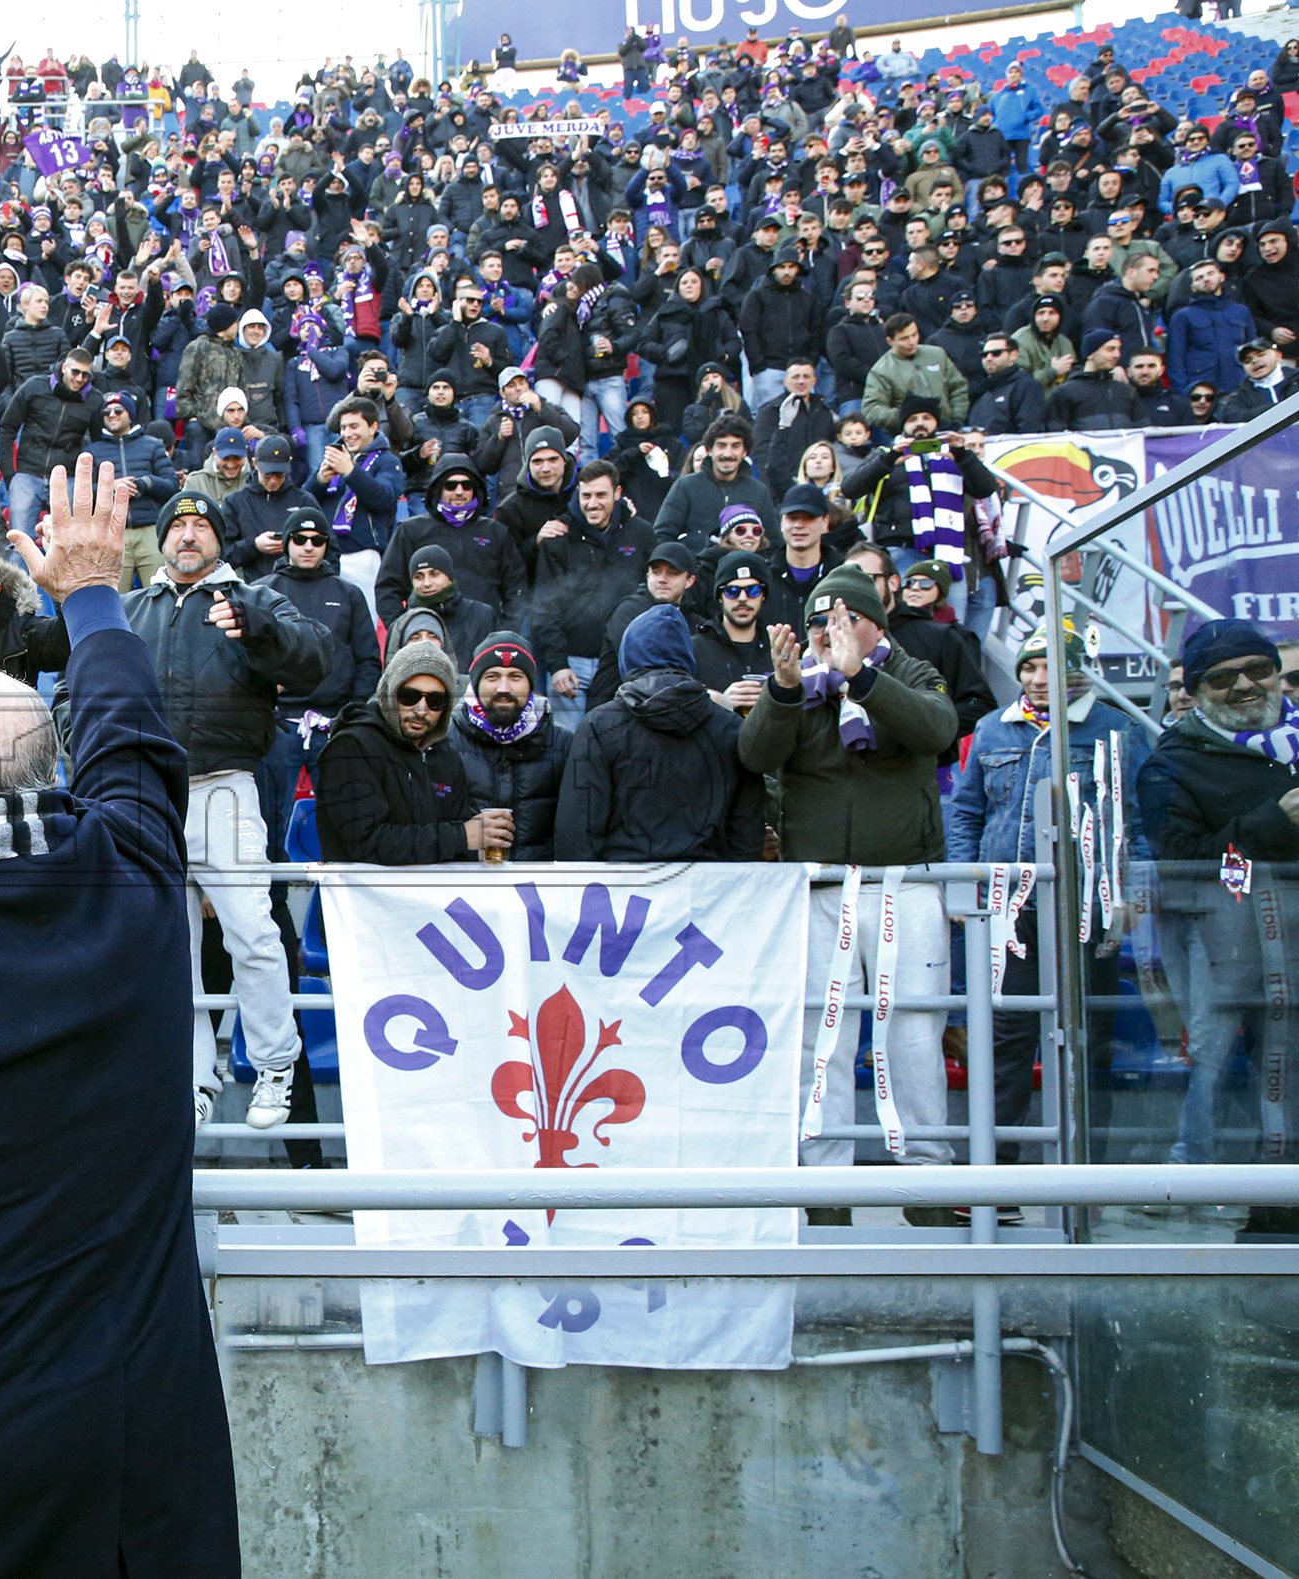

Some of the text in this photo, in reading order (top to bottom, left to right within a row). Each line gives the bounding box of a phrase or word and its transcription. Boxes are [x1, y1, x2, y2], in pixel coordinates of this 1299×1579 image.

[494, 121, 601, 136] JUVE MERDA
[50, 140, 79, 167] 13
[839, 903, 852, 951] GIOTTI
[883, 894, 895, 943] GIOTTI
[363, 881, 768, 1085] QUINTO
[825, 980, 842, 1029] GIOTTI
[876, 974, 889, 1021] GIOTTI
[875, 1052, 888, 1100] GIOTTI
